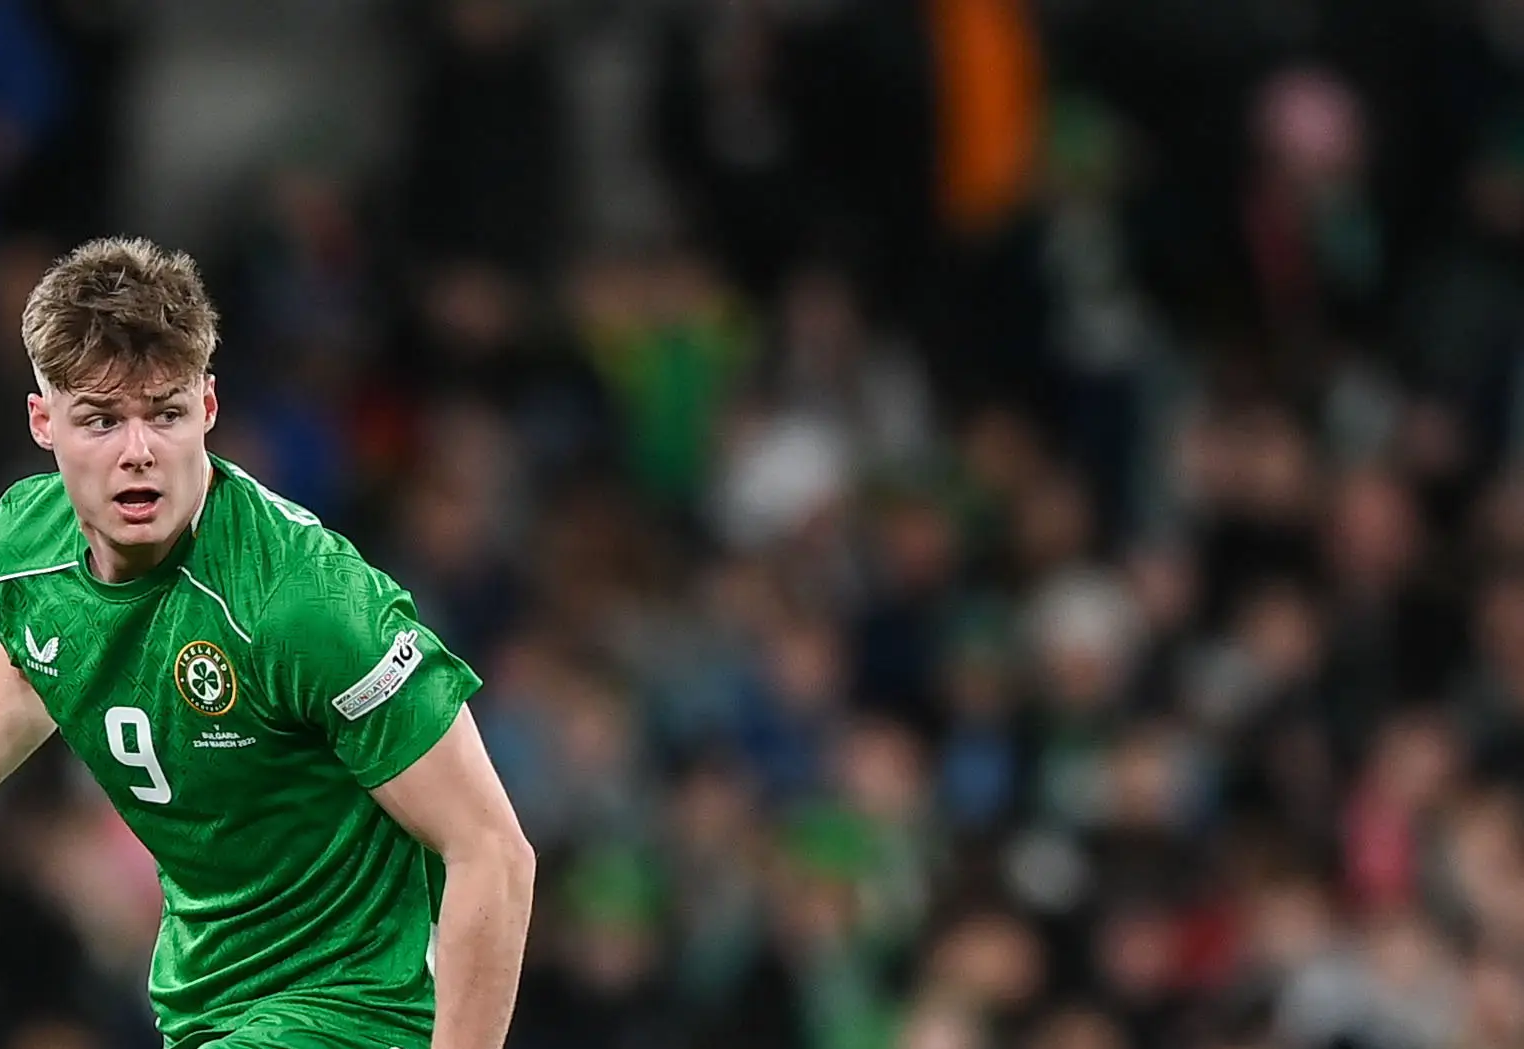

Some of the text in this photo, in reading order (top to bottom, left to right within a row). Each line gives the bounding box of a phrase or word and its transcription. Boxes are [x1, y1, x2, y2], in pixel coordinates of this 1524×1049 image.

[179, 644, 228, 672] IRELAND
[392, 644, 413, 669] 10
[342, 666, 397, 712] FOUNDATION
[104, 706, 172, 804] 9
